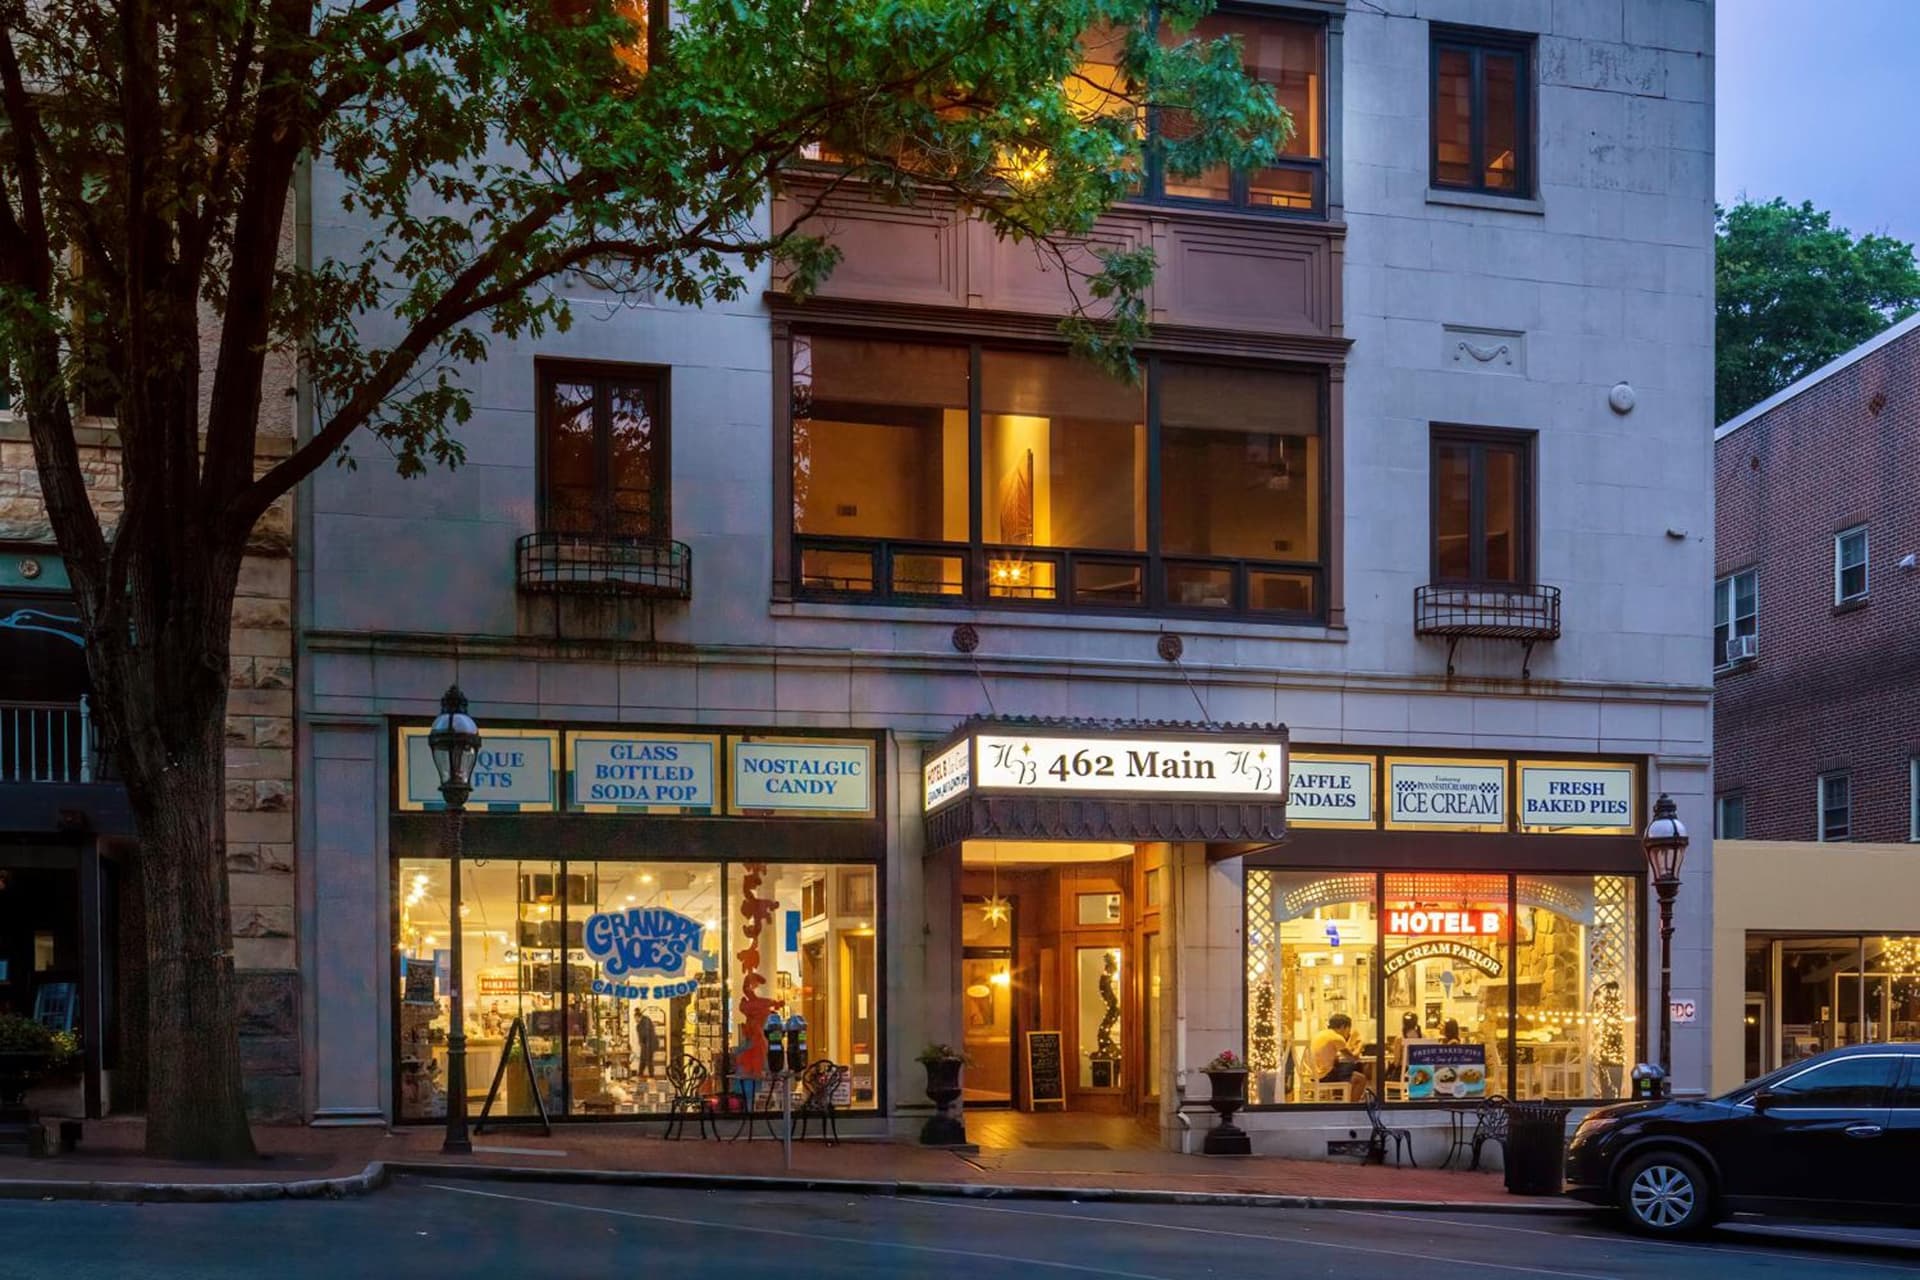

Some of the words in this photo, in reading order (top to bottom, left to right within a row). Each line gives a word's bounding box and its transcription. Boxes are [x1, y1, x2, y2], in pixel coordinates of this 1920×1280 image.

[610, 743, 678, 760] GLASS
[478, 751, 525, 771] QUE
[743, 758, 861, 776] NOSTALGIC
[1049, 749, 1115, 782] 462
[1126, 750, 1216, 779] Main
[474, 772, 512, 788] FTS
[596, 764, 694, 780] BOTTLED
[591, 783, 649, 799] SODA
[656, 786, 697, 801] POP
[765, 778, 838, 794] CANDY
[1549, 781, 1605, 796] FRESH
[1396, 791, 1428, 813] ICE
[1431, 793, 1499, 815] CREAM
[1527, 799, 1585, 813] BAKED
[1590, 800, 1627, 814] PIES
[1391, 911, 1476, 933] HOTEL
[1482, 912, 1499, 933] B
[586, 909, 704, 955] GRANDPA
[606, 937, 687, 976] JOE'S
[1384, 955, 1406, 975] ICE
[1404, 942, 1450, 962] CREAM
[1452, 943, 1501, 975] PARLOR
[592, 980, 649, 999] CANDY
[653, 980, 698, 999] SHOP
